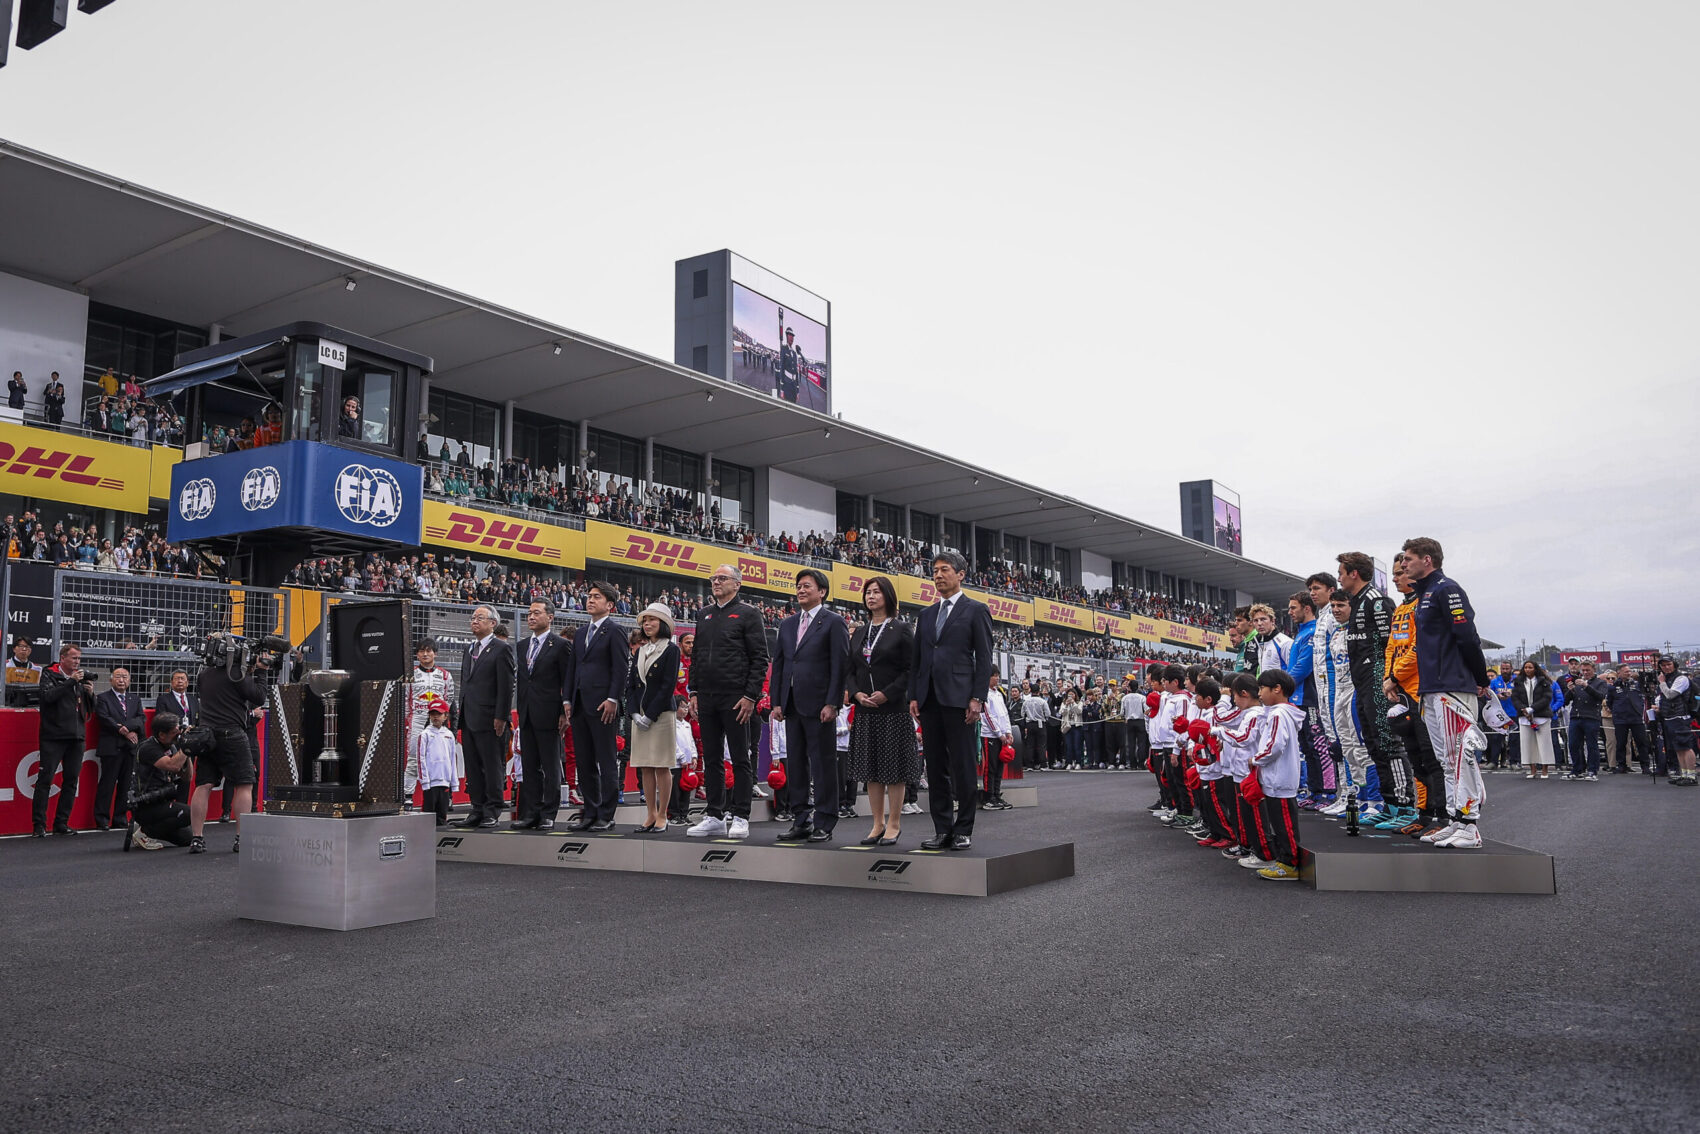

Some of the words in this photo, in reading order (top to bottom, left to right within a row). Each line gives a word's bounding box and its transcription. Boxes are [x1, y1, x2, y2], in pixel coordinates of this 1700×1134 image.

[320, 345, 331, 358] LC
[332, 348, 345, 362] 0.5
[446, 512, 544, 556] DHL
[625, 534, 699, 571] DHL
[769, 579, 789, 588] FASTEST
[1049, 604, 1078, 625] DHL
[90, 619, 124, 629] aramco
[87, 638, 113, 648] QATAR
[322, 839, 333, 851] IN
